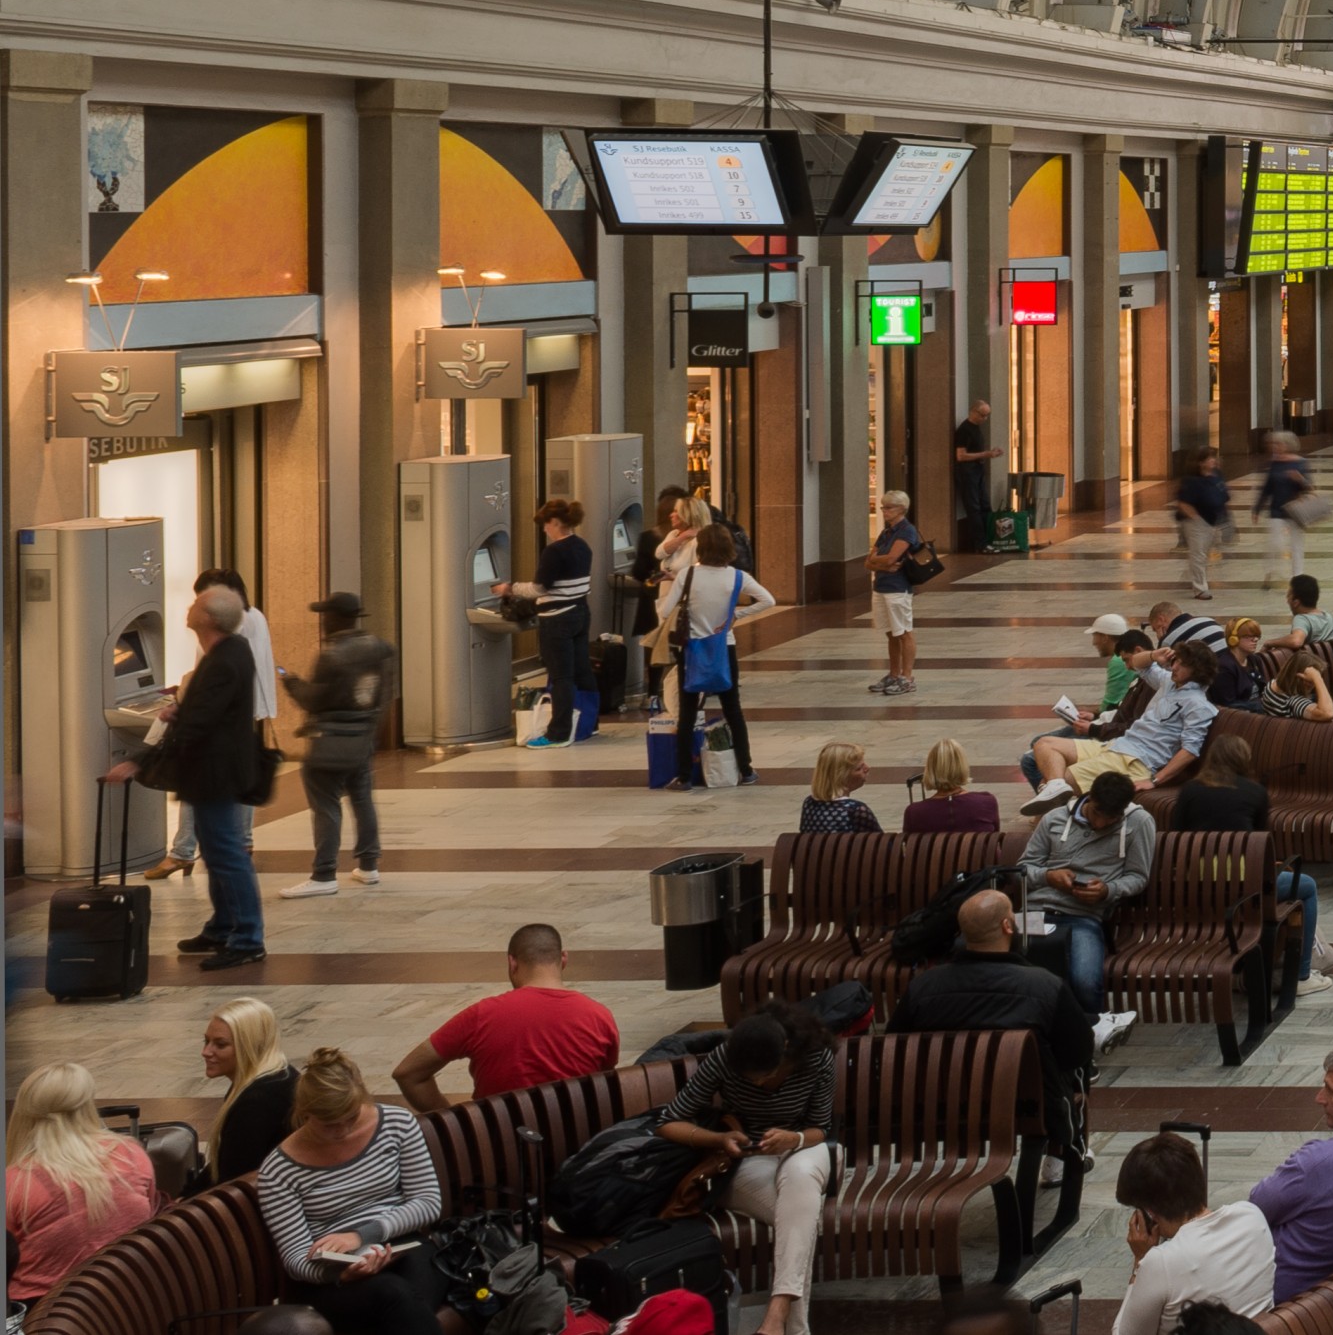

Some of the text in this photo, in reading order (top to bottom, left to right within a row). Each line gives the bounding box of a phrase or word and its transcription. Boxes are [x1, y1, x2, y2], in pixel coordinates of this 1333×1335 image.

[623, 157, 685, 167] Kundsupport
[633, 172, 687, 180] Kundsupport
[655, 198, 682, 206] Inrikes
[738, 198, 745, 206] 9
[658, 211, 686, 219] Inrikes
[740, 212, 752, 220] 15
[875, 297, 916, 307] TOURIST
[461, 339, 486, 363] SJ
[691, 344, 743, 357] Glitter
[100, 366, 130, 395] SJ
